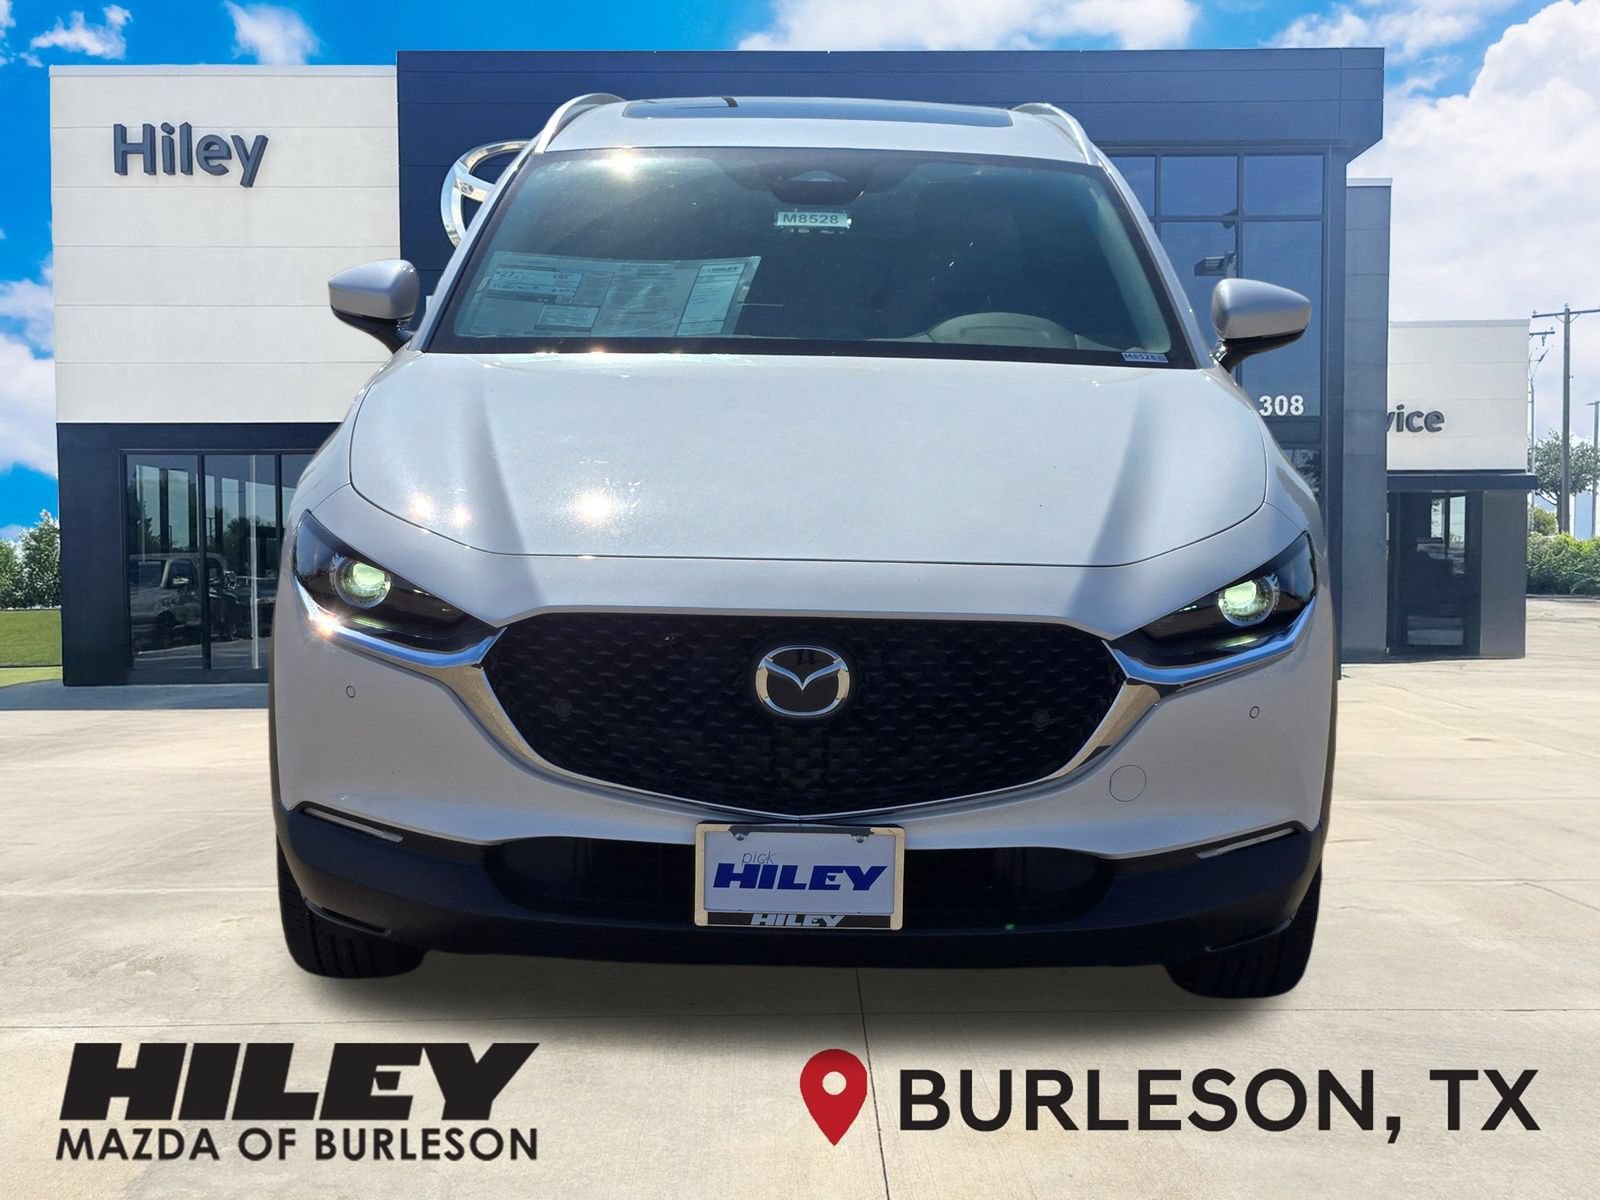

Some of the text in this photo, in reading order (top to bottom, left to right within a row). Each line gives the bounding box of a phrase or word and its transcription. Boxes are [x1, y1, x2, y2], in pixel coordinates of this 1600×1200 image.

[113, 121, 269, 188] Hiley
[783, 213, 839, 224] M8528
[1258, 395, 1305, 416] 308
[742, 851, 775, 866] pick
[712, 863, 888, 891] HILEY
[751, 913, 846, 927] HILEY
